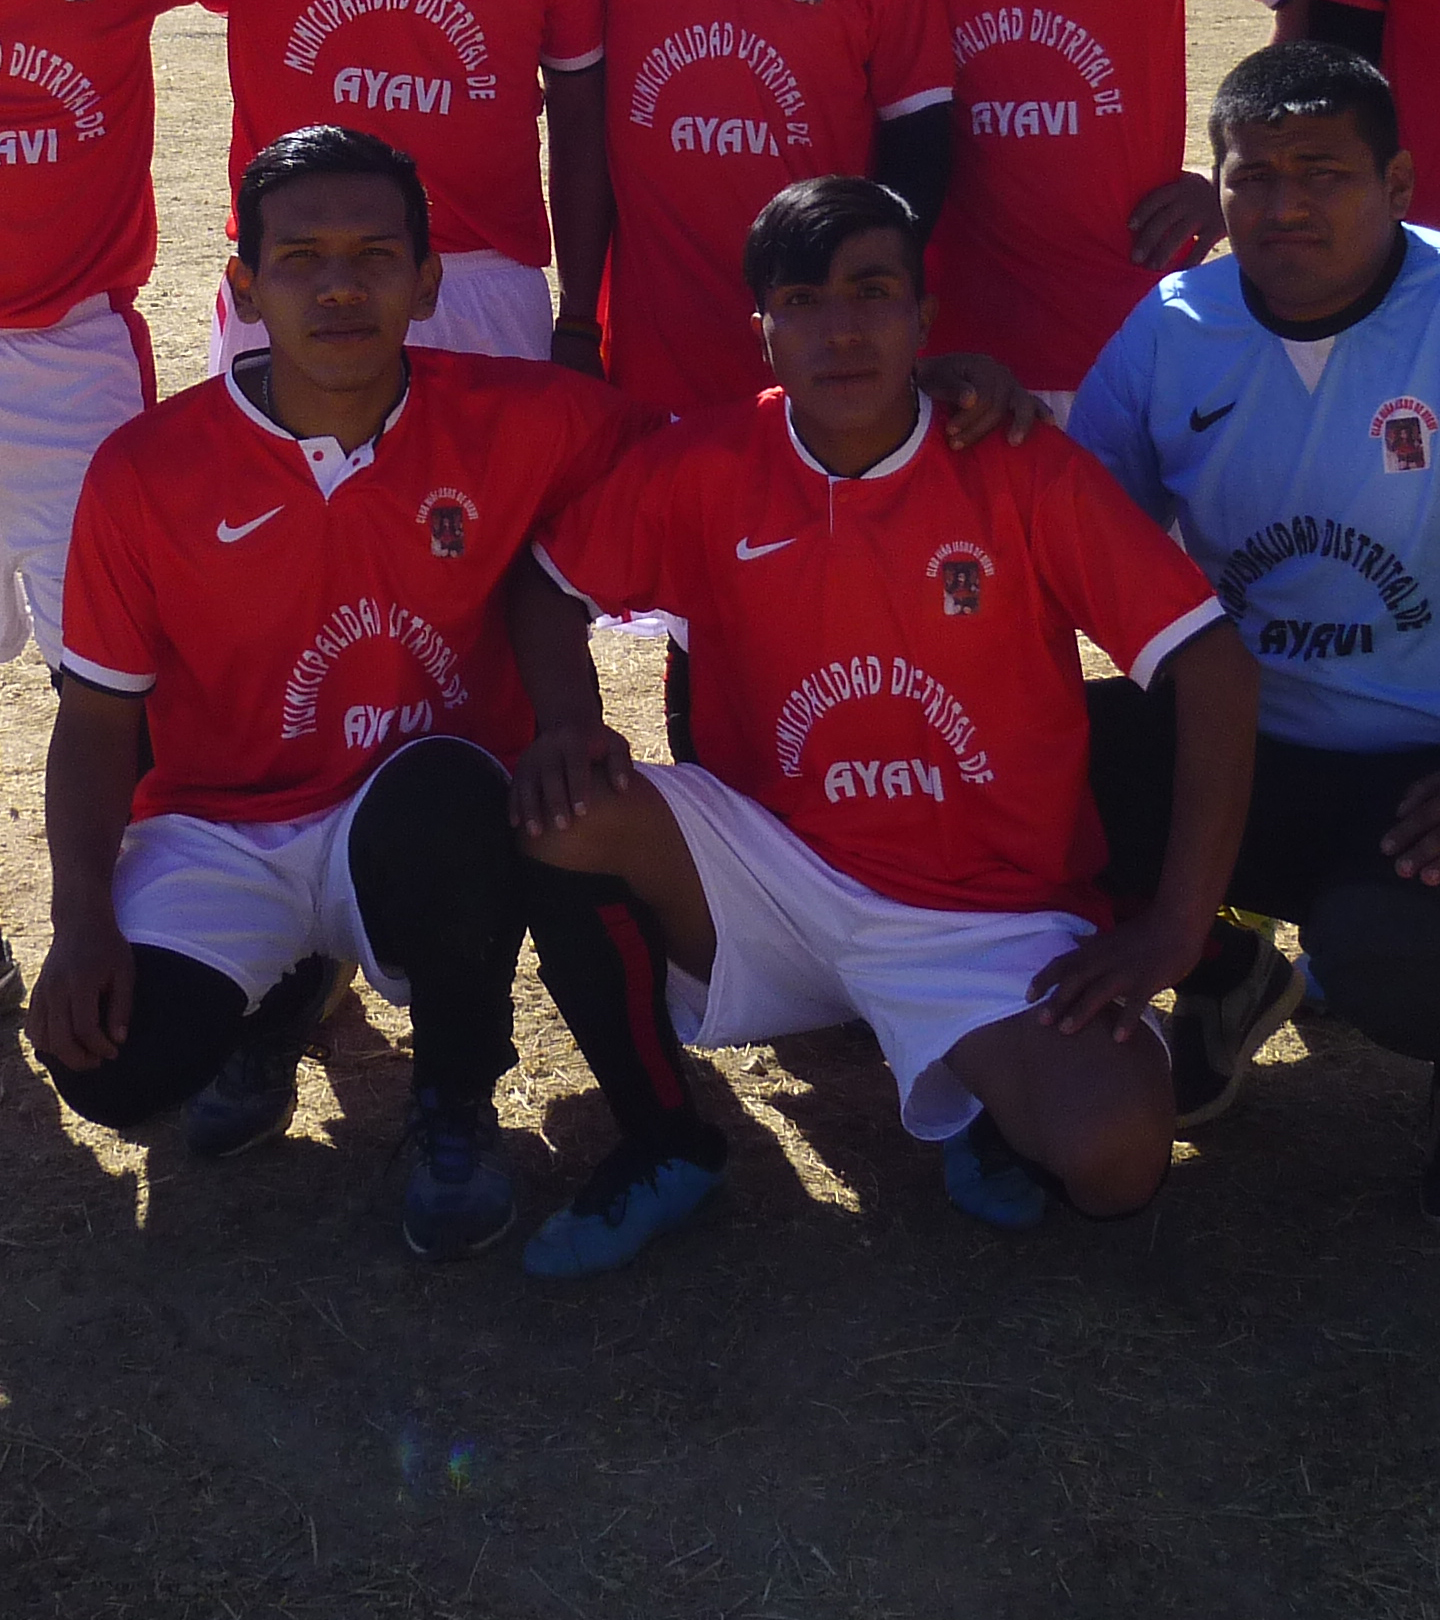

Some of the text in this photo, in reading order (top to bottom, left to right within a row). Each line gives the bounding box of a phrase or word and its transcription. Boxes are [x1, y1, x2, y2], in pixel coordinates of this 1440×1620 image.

[466, 74, 498, 101] DE
[629, 20, 735, 129] MUNICIPALIDAD
[1029, 8, 1115, 90] DISTRITAL
[1093, 88, 1123, 118] DE
[10, 42, 102, 118] DISTRITAL
[75, 112, 108, 143] DE
[333, 66, 452, 116] AYAVI
[970, 100, 1079, 140] AYAVI
[1320, 518, 1420, 612] DISTRITAL
[1395, 597, 1432, 633] DE
[1259, 618, 1374, 663] AYAVI
[958, 750, 995, 785] DE
